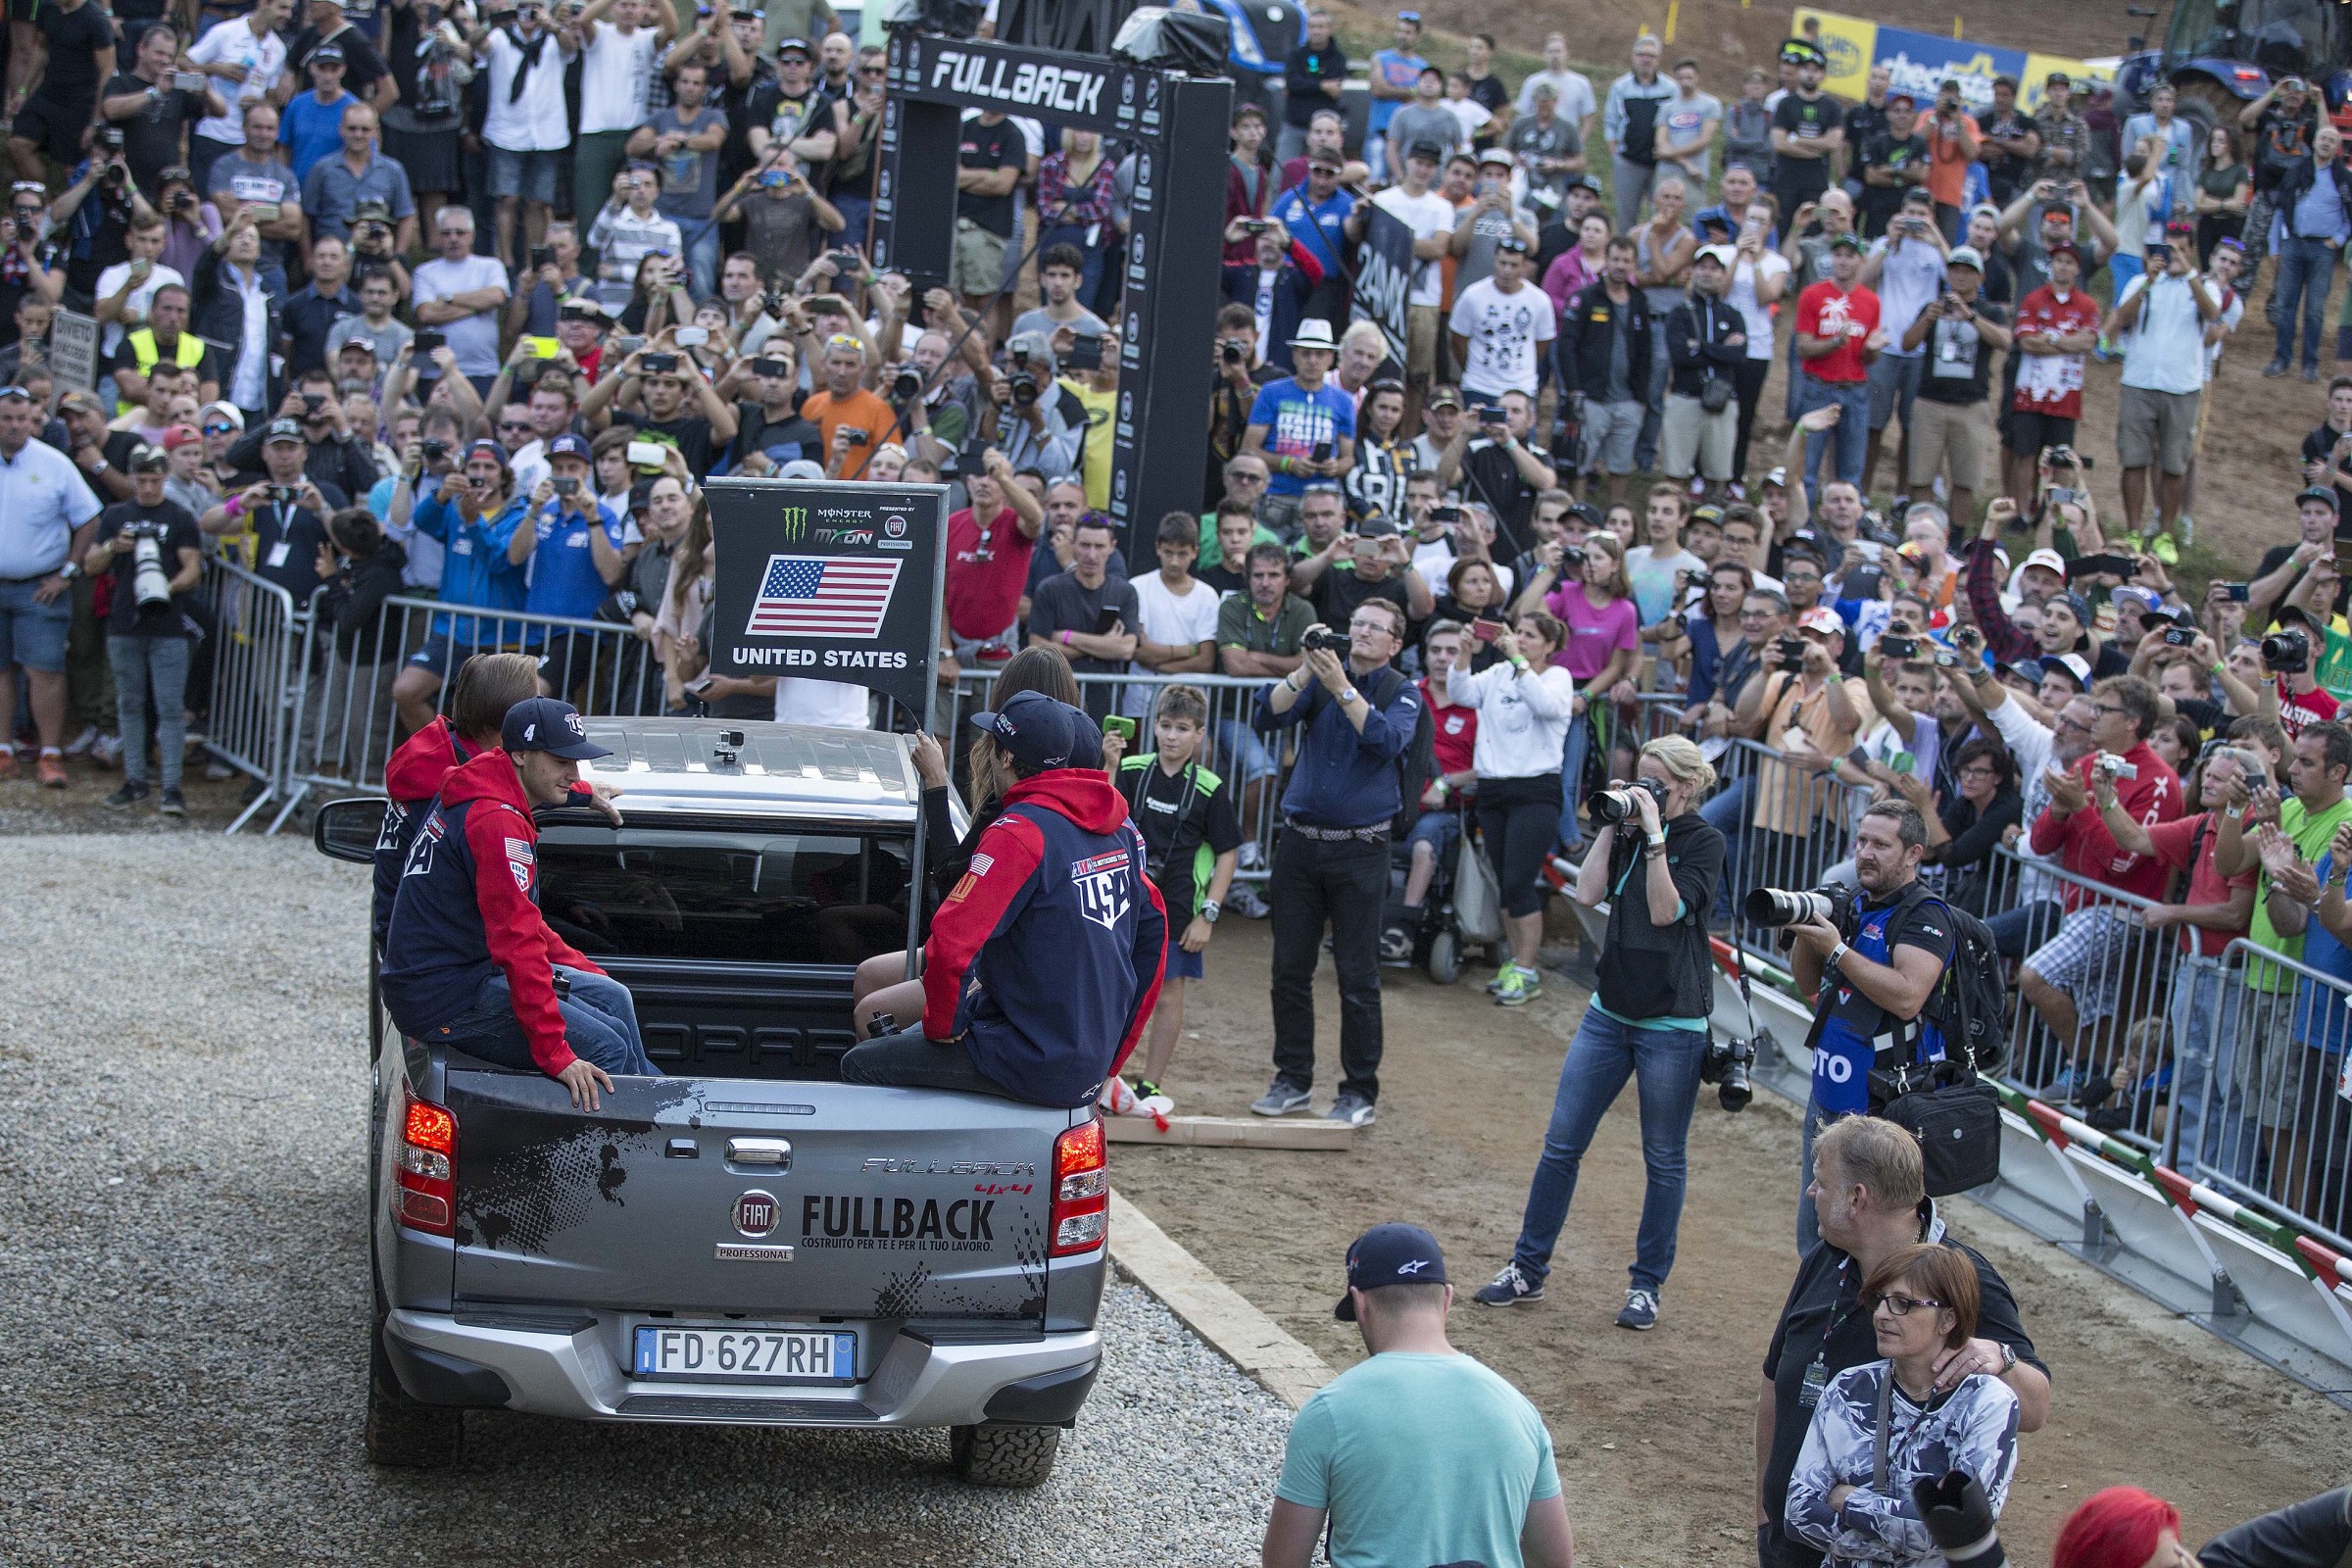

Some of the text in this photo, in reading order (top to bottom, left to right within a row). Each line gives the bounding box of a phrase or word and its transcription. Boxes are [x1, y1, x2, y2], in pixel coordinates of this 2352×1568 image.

[931, 51, 1105, 115] FULLBACK
[817, 508, 872, 519] MONSTER
[890, 521, 903, 532] FIAT
[732, 648, 907, 668] UNITED STATES
[524, 724, 535, 742] 4
[860, 1157, 1035, 1176] FULLBACK
[974, 1183, 1034, 1195] 4x4
[743, 1203, 771, 1226] FIAT
[802, 1195, 996, 1241] FULLBACK
[719, 1249, 789, 1259] PROFESSIONAL
[802, 1238, 994, 1252] COSTRUITO PER TE E PER IL TUO LAVORO.
[662, 1333, 829, 1374] FD 627RH
